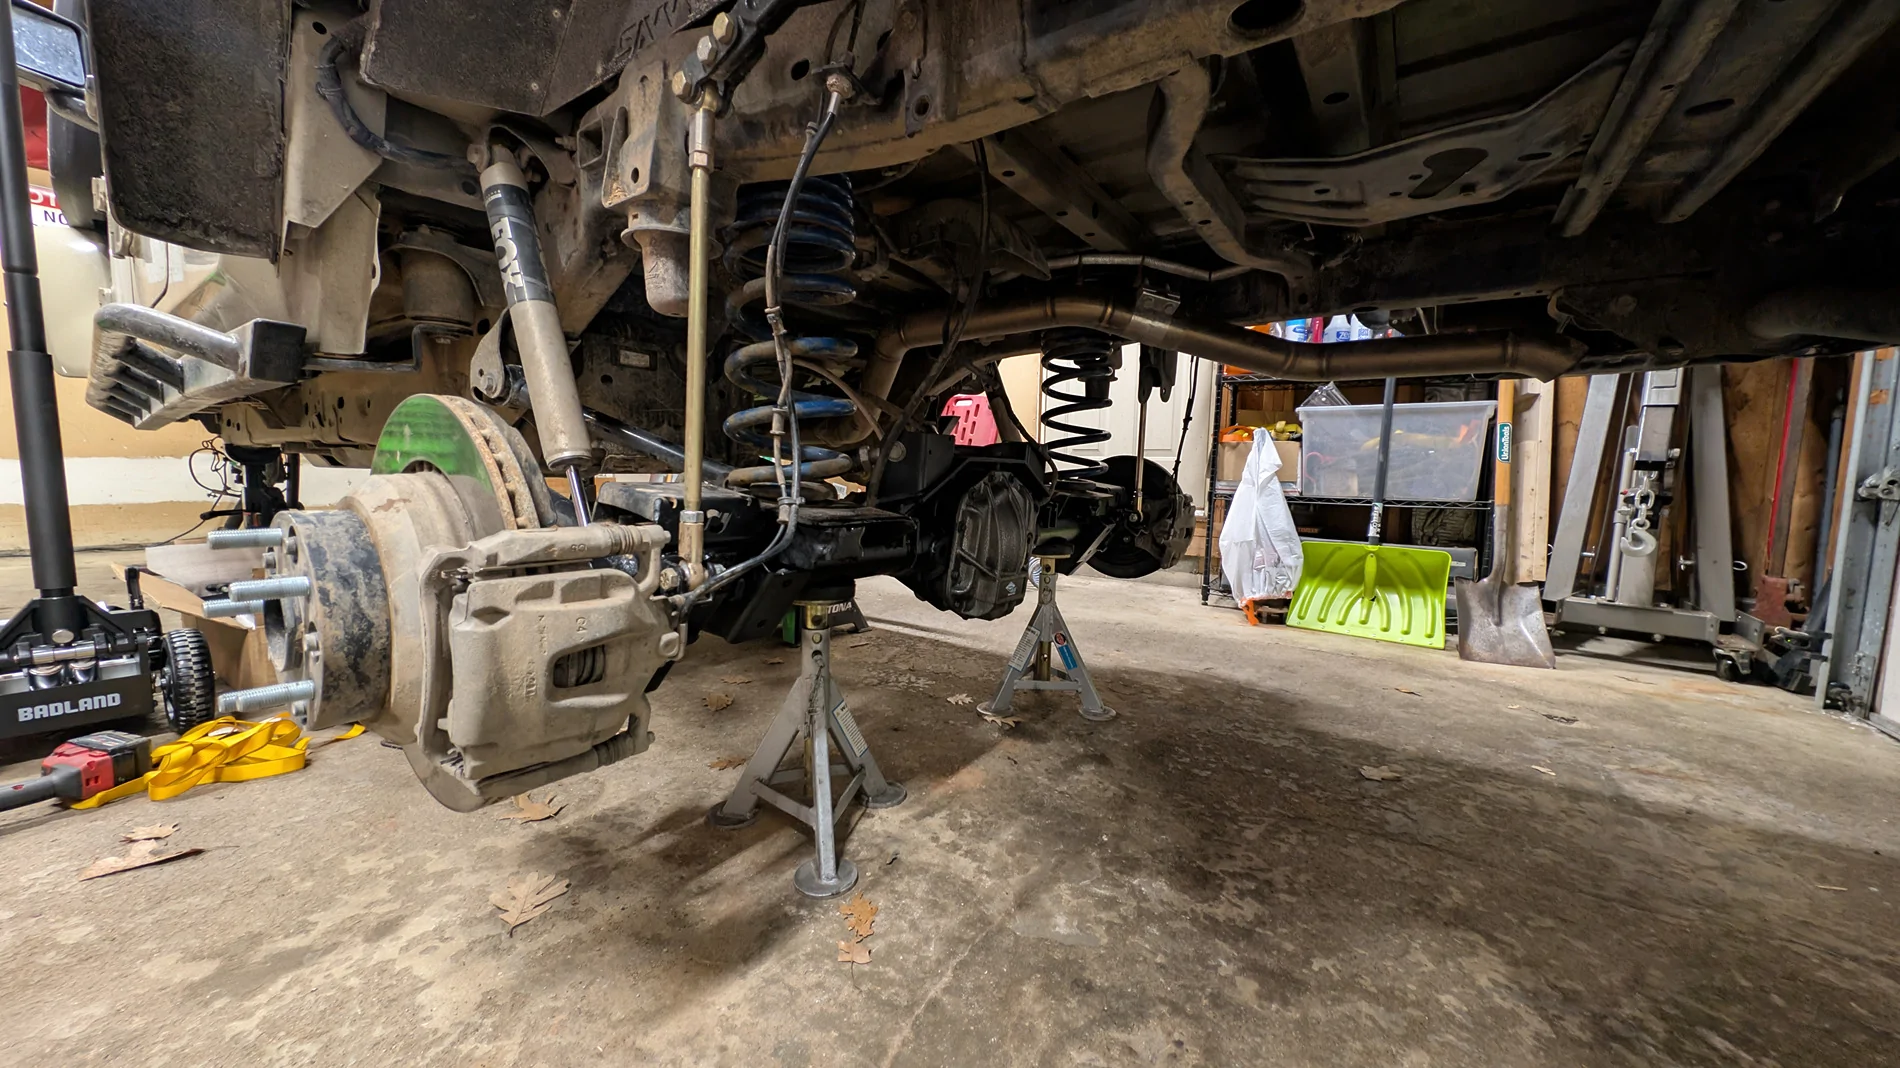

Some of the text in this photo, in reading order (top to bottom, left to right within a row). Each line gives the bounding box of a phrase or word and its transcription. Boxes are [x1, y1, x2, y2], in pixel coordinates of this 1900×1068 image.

[491, 216, 524, 291] FOX
[827, 601, 852, 614] TONA
[17, 692, 121, 722] BADLAND
